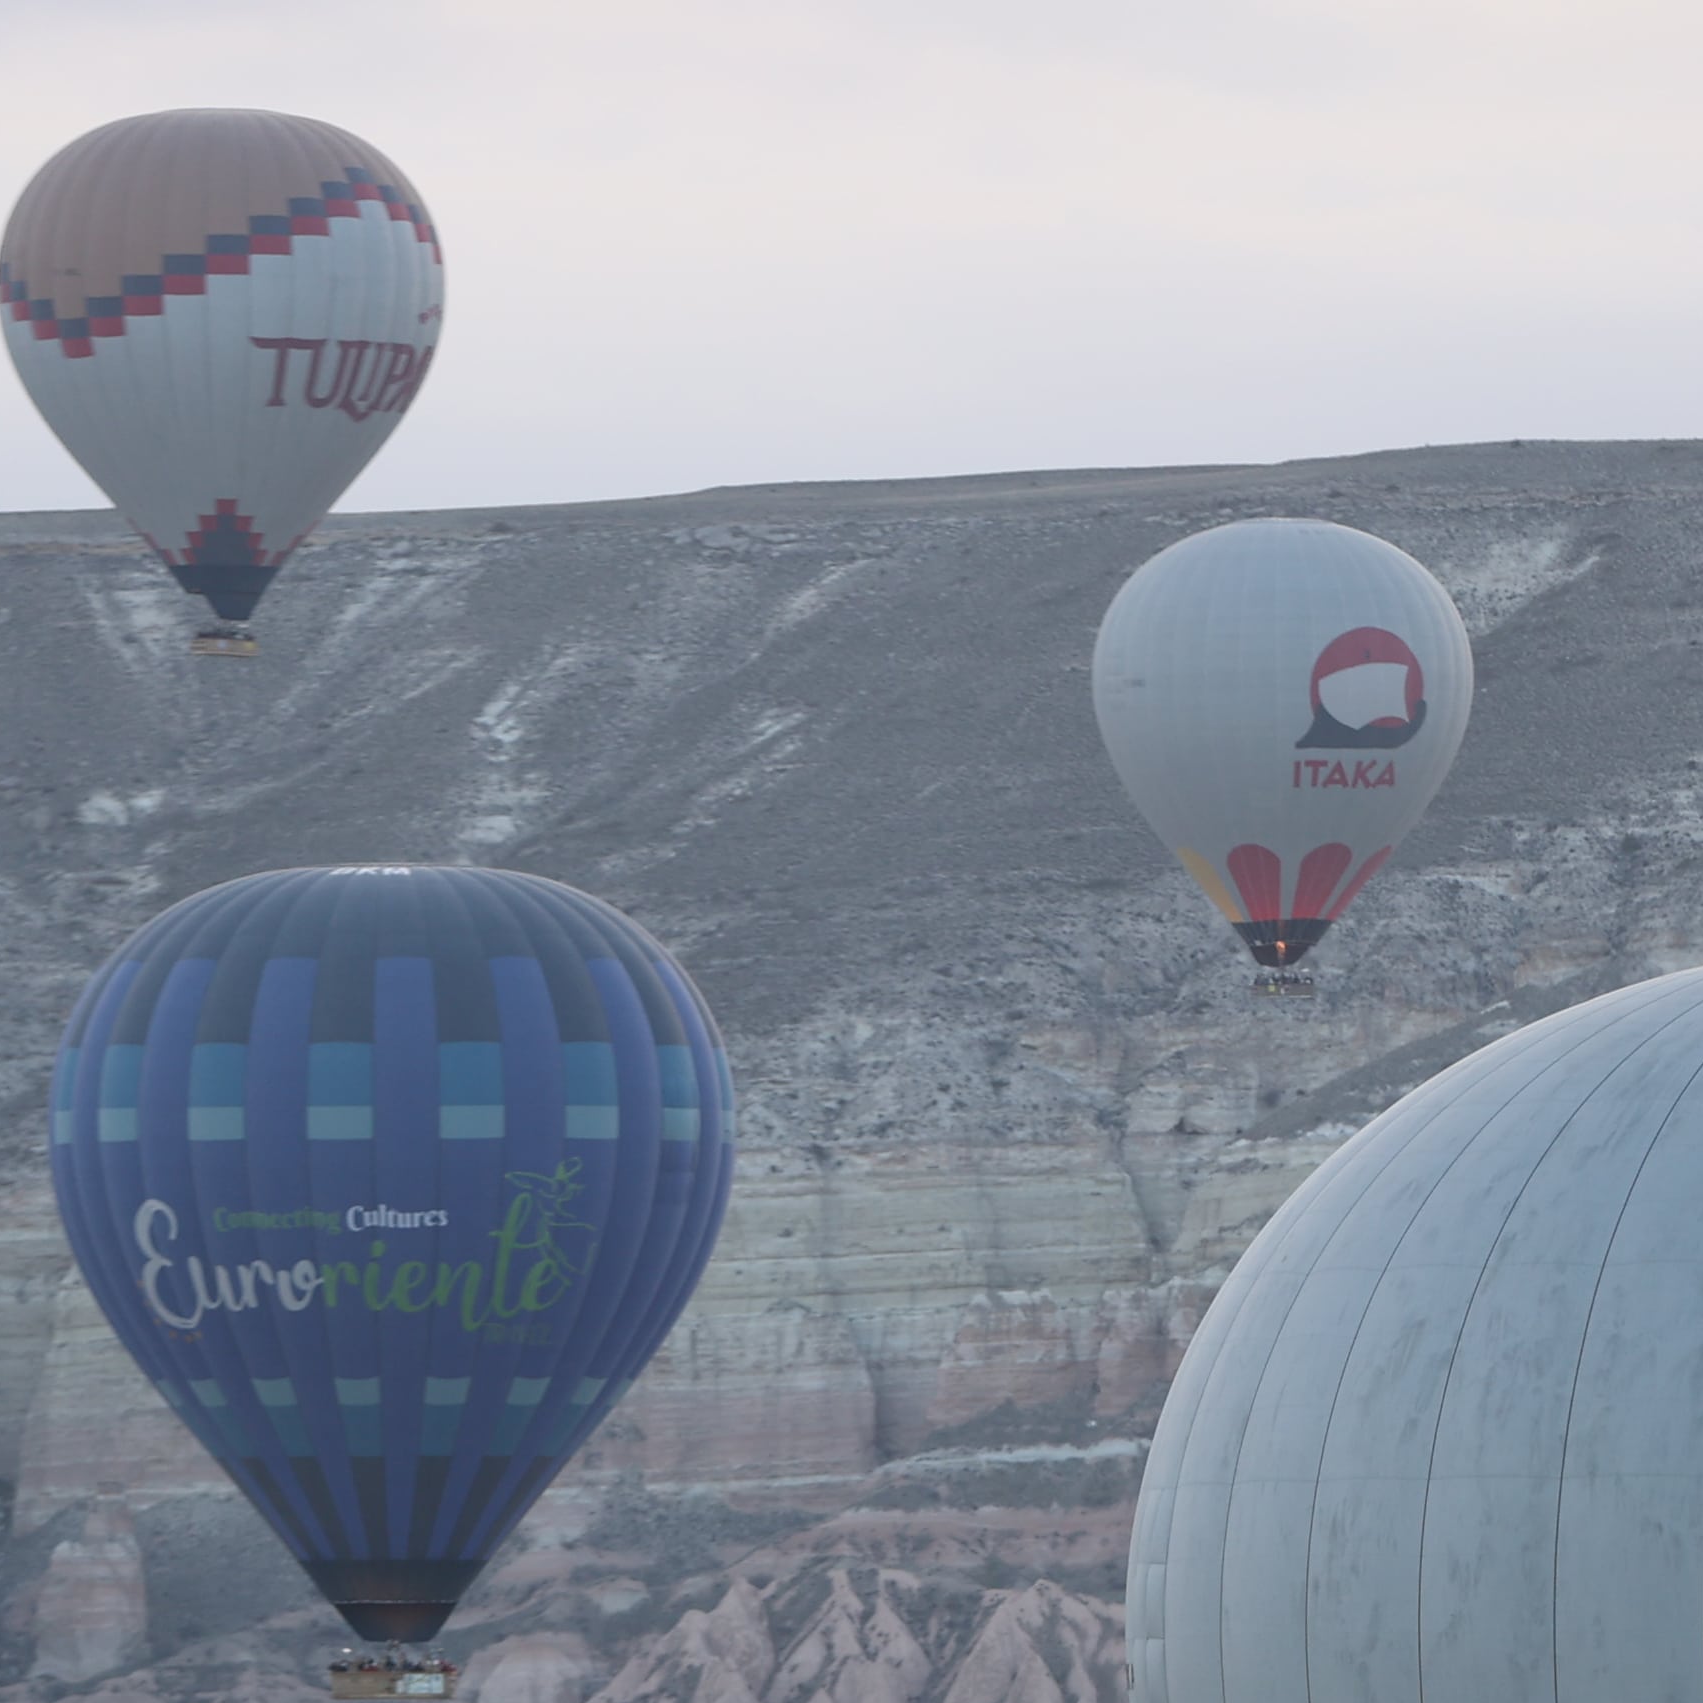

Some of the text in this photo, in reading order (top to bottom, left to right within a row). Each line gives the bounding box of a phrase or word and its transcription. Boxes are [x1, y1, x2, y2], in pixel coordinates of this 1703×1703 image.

[1293, 759, 1395, 788] ITAKA
[347, 1204, 448, 1232] Cultures
[134, 1191, 567, 1332] Euroriente
